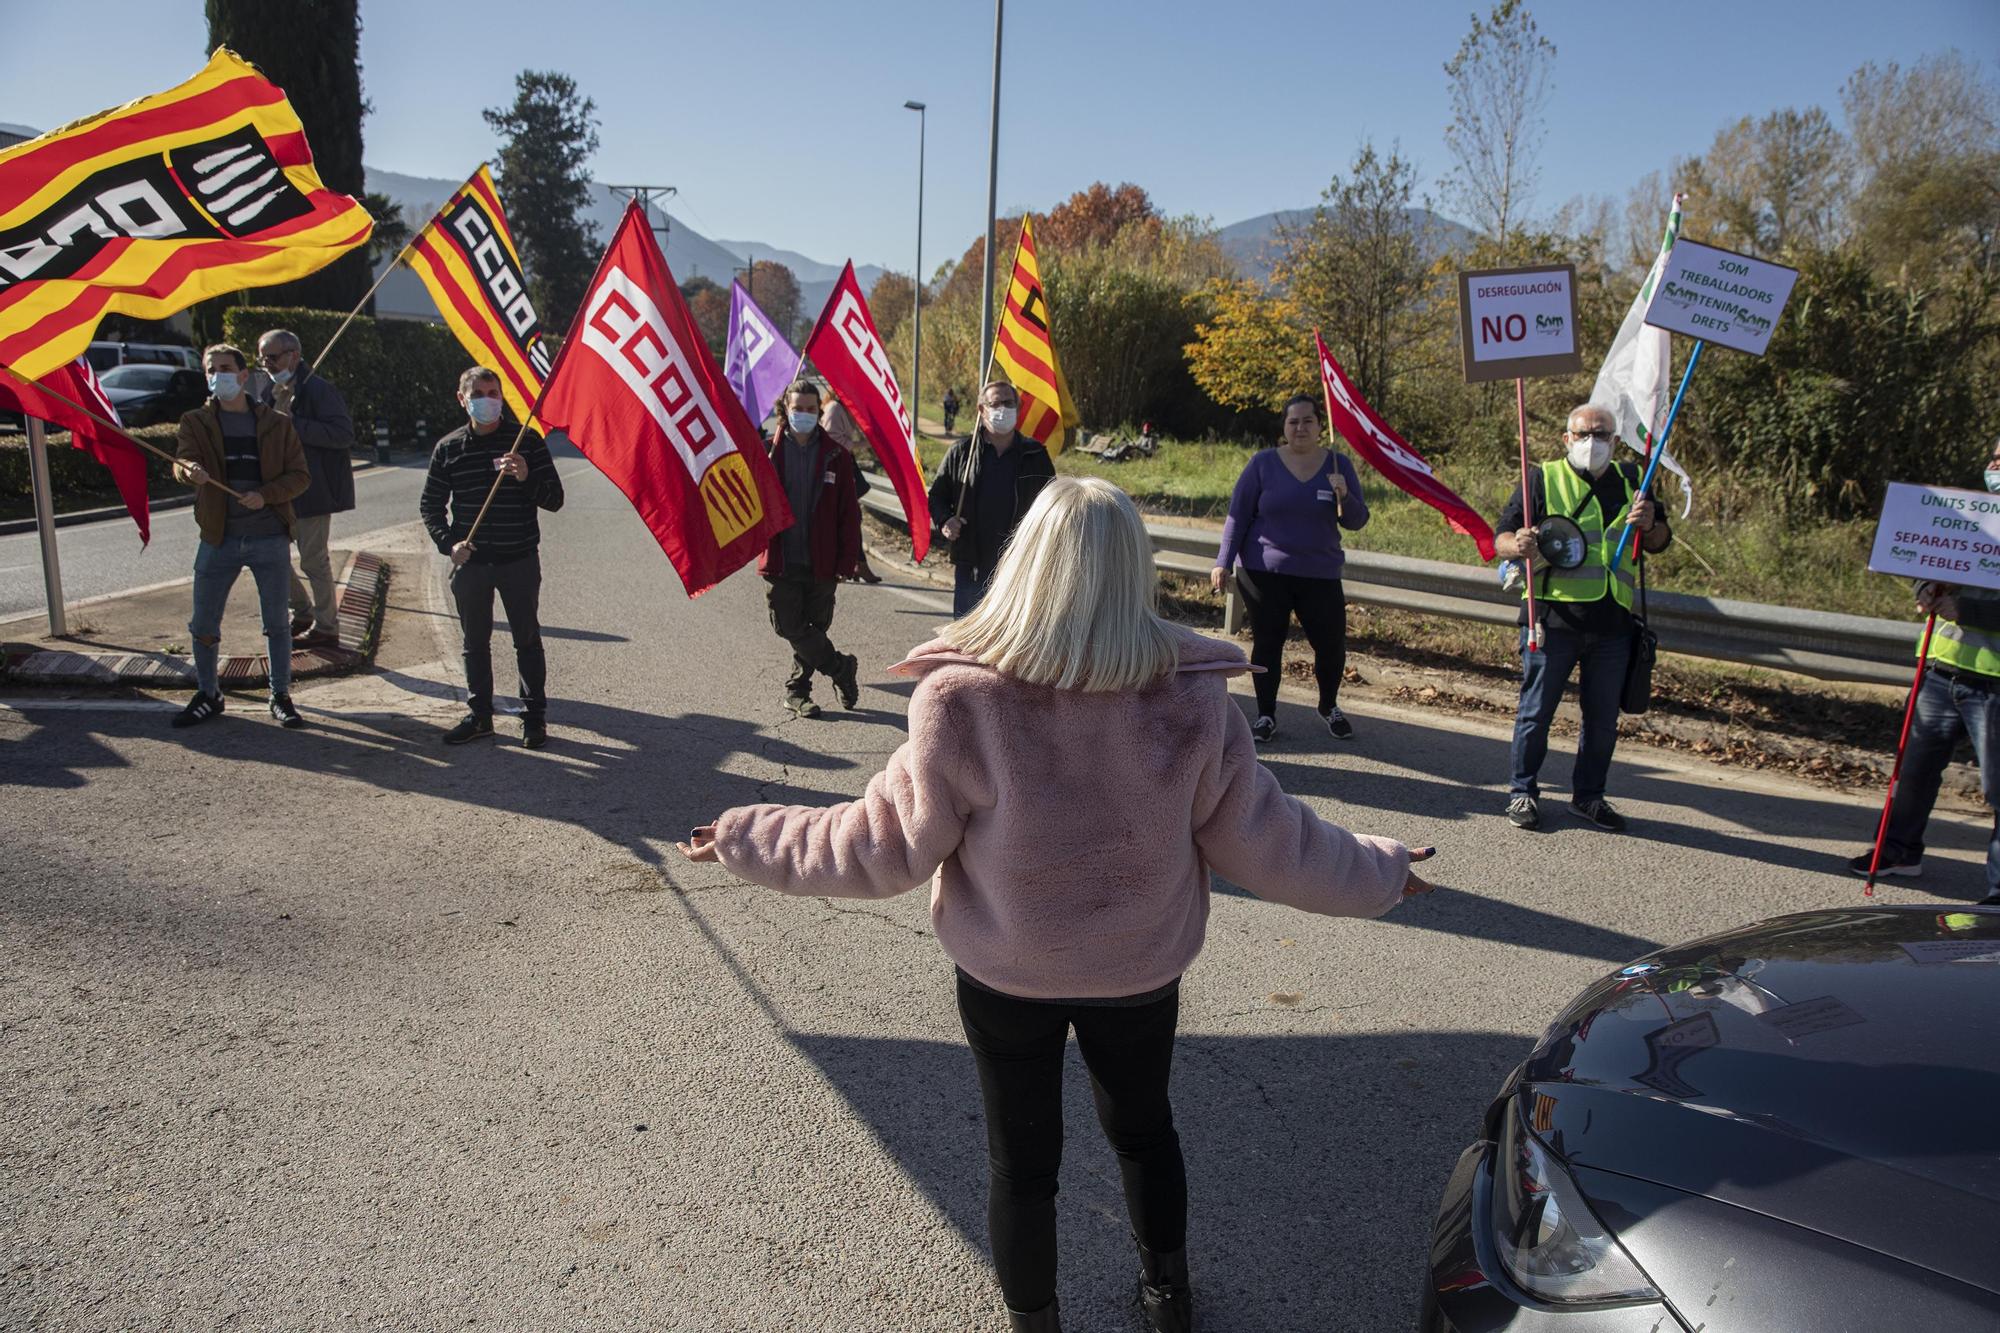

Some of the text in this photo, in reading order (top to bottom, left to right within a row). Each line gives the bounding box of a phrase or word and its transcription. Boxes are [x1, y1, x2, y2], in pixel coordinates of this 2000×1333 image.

[453, 205, 538, 338] CCOO
[1717, 259, 1750, 277] SOM
[1477, 280, 1562, 299] DESREGULACIÓN
[1680, 268, 1775, 305] TREBALLADORS
[1699, 294, 1739, 315] TENIM
[1481, 313, 1527, 345] NO
[1690, 312, 1731, 333] DRETS
[589, 288, 717, 457] CCOO
[1920, 494, 1966, 511] UNITS
[1931, 516, 1980, 533] FORTS
[1893, 530, 1969, 552] SEPARATS
[1920, 554, 1972, 572] FEBLES
